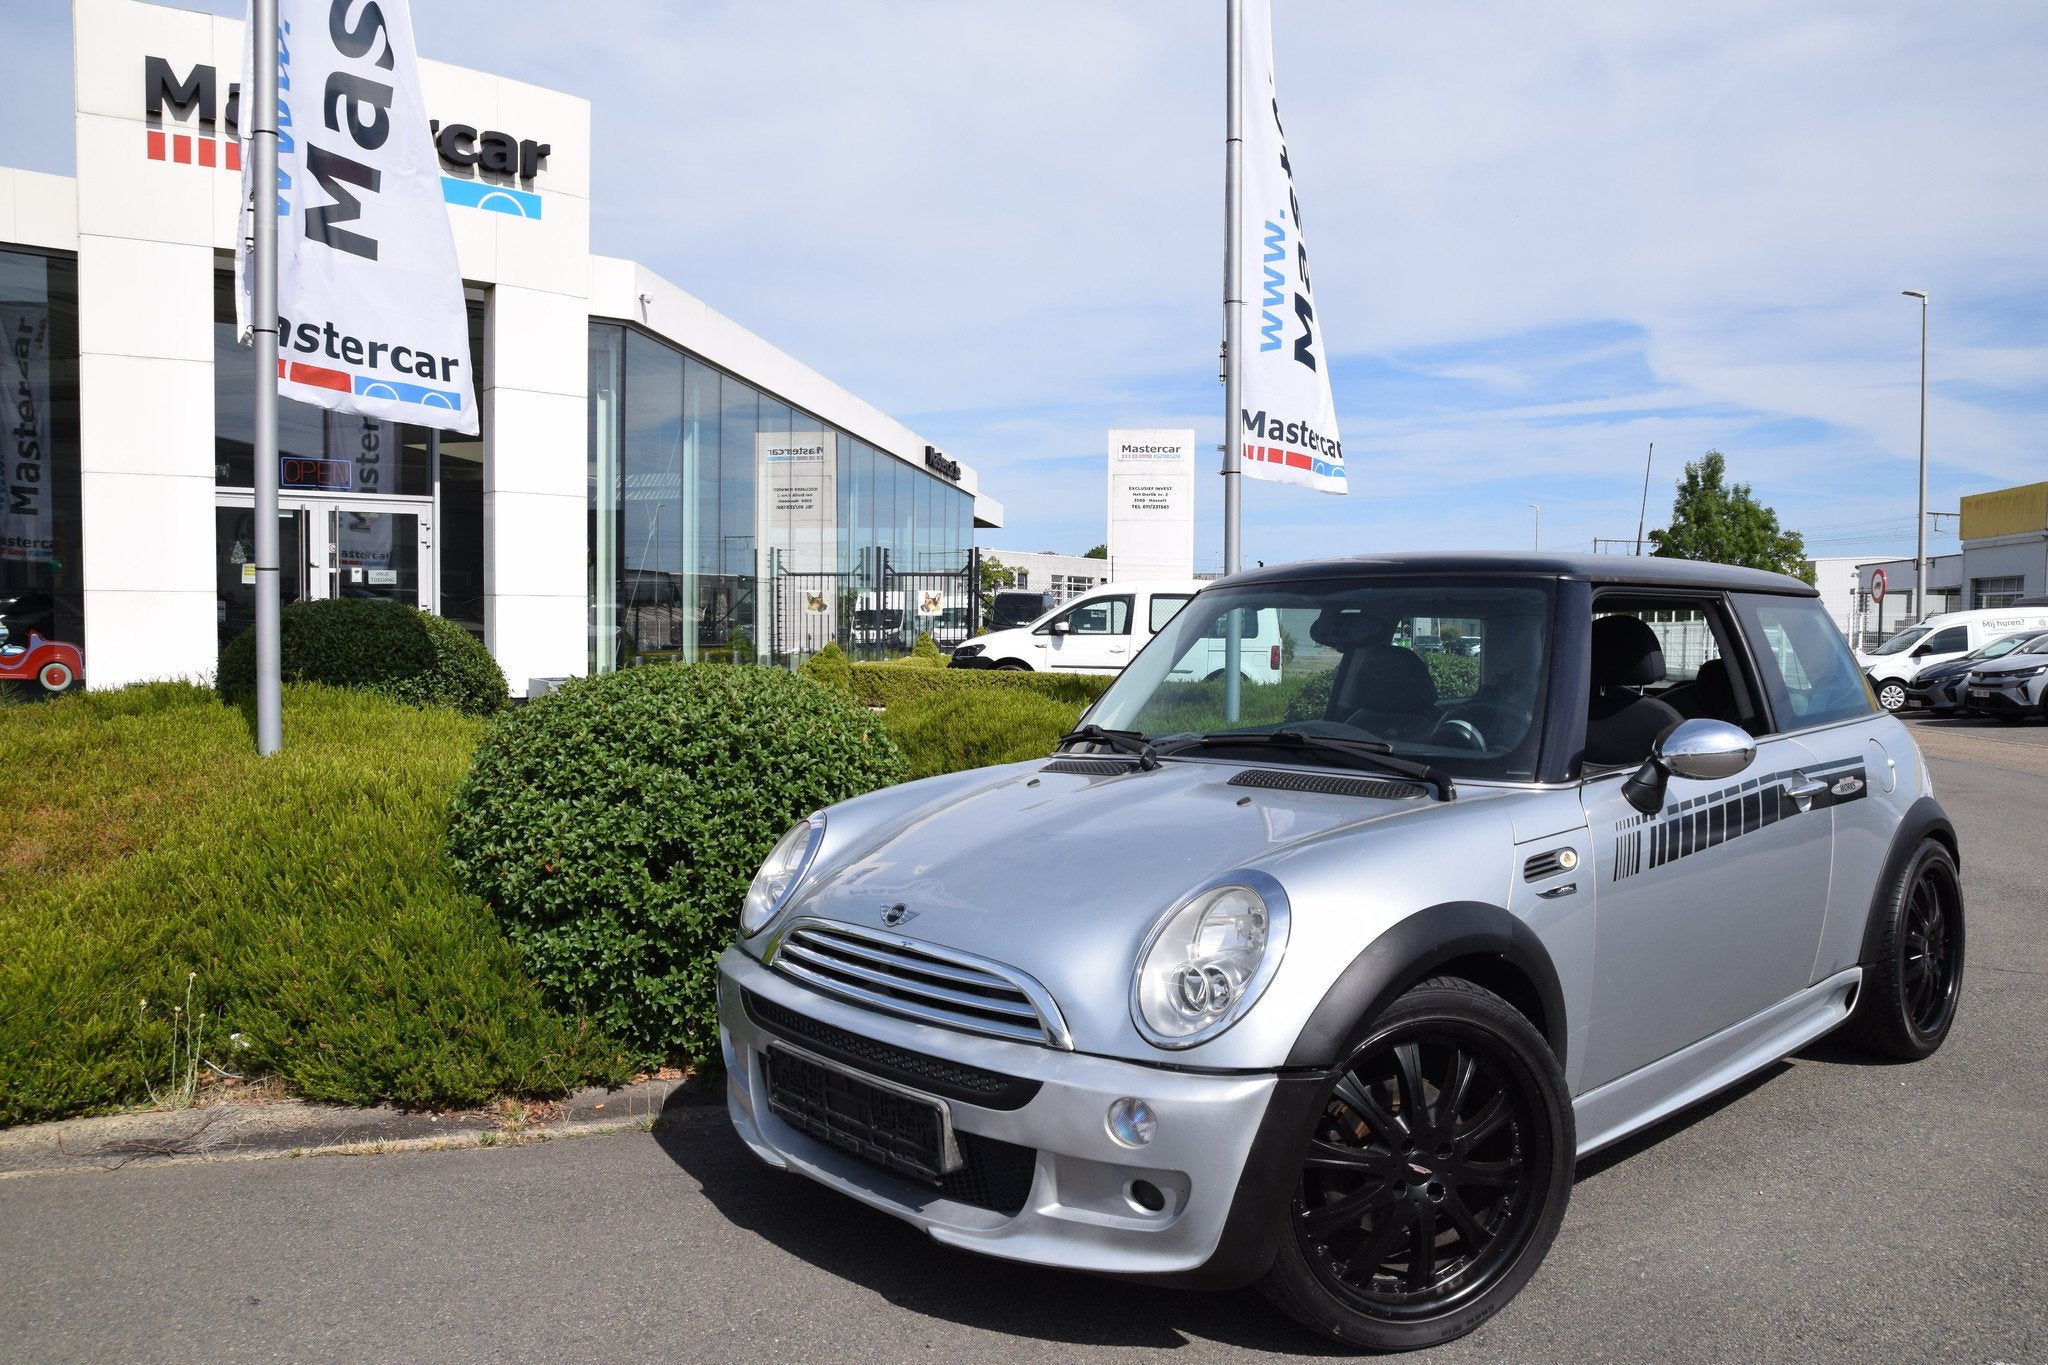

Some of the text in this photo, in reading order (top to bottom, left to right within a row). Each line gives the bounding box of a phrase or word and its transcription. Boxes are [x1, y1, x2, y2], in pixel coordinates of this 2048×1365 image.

[1260, 208, 1286, 353] www.
[1121, 444, 1181, 454] Mastercar
[283, 459, 349, 485] OPEN
[1982, 618, 2025, 629] Mij huren?
